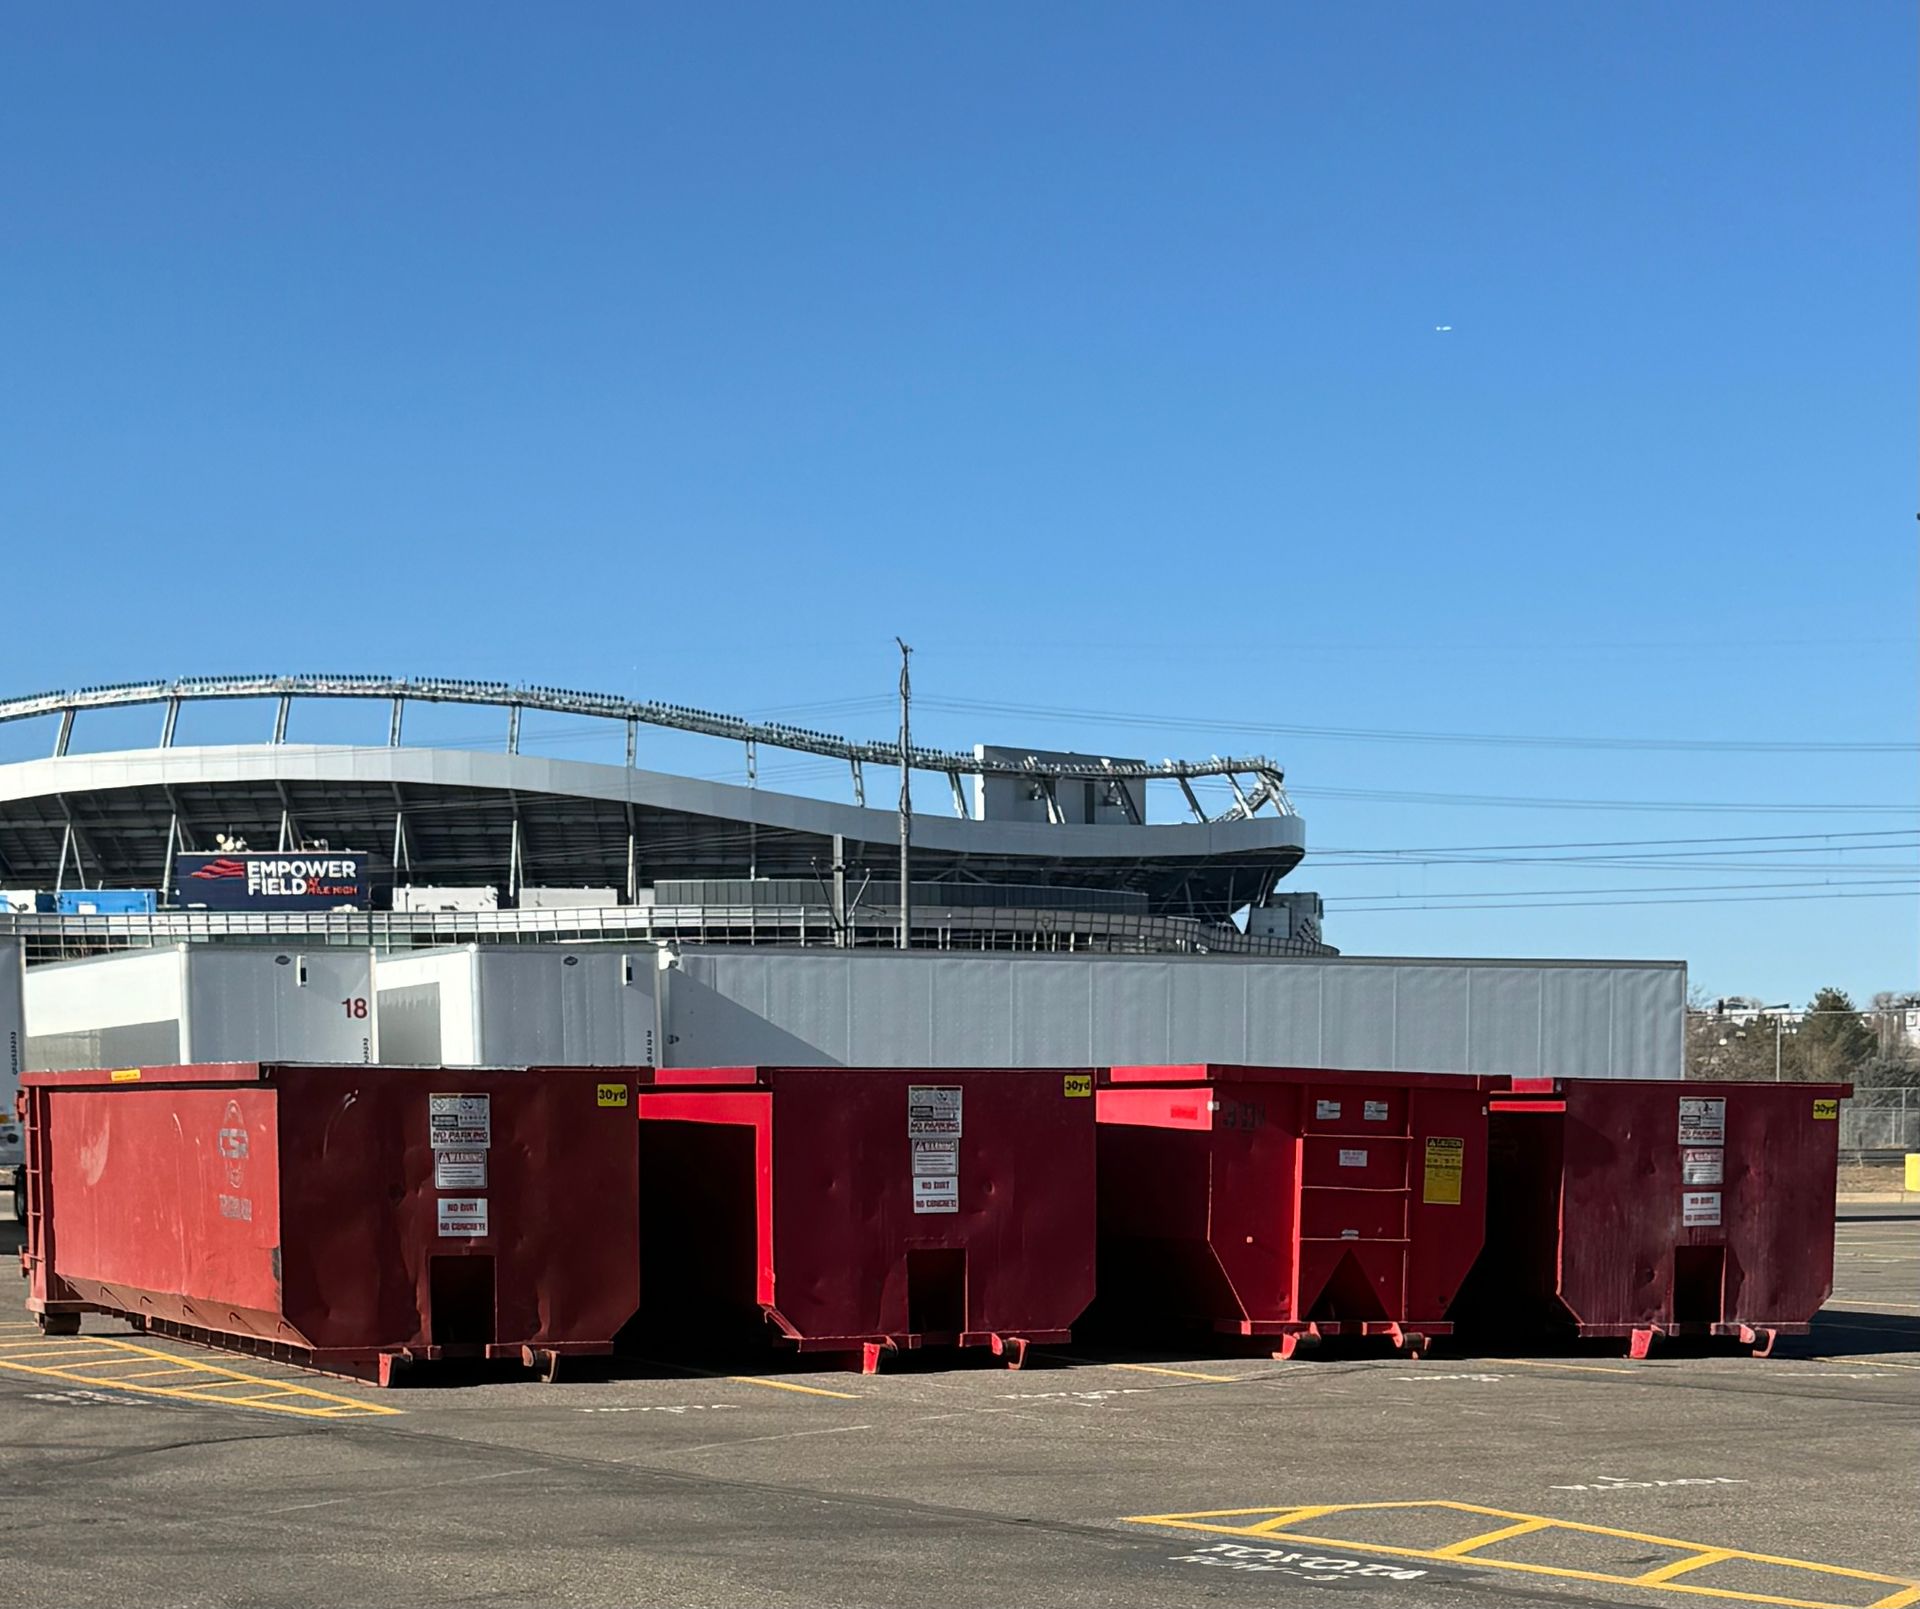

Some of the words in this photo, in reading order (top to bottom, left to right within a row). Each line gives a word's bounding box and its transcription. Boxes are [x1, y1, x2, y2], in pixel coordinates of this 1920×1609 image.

[247, 861, 356, 878] EMPOWER
[248, 878, 307, 895] FIELD
[341, 998, 368, 1019] 18
[1066, 1080, 1090, 1092] 30yd
[599, 1088, 626, 1101] 30yd
[449, 1153, 483, 1163] WARNING
[448, 1203, 458, 1212] NO
[460, 1203, 478, 1212] DIRT
[1193, 1543, 1429, 1580] TOYOTA
